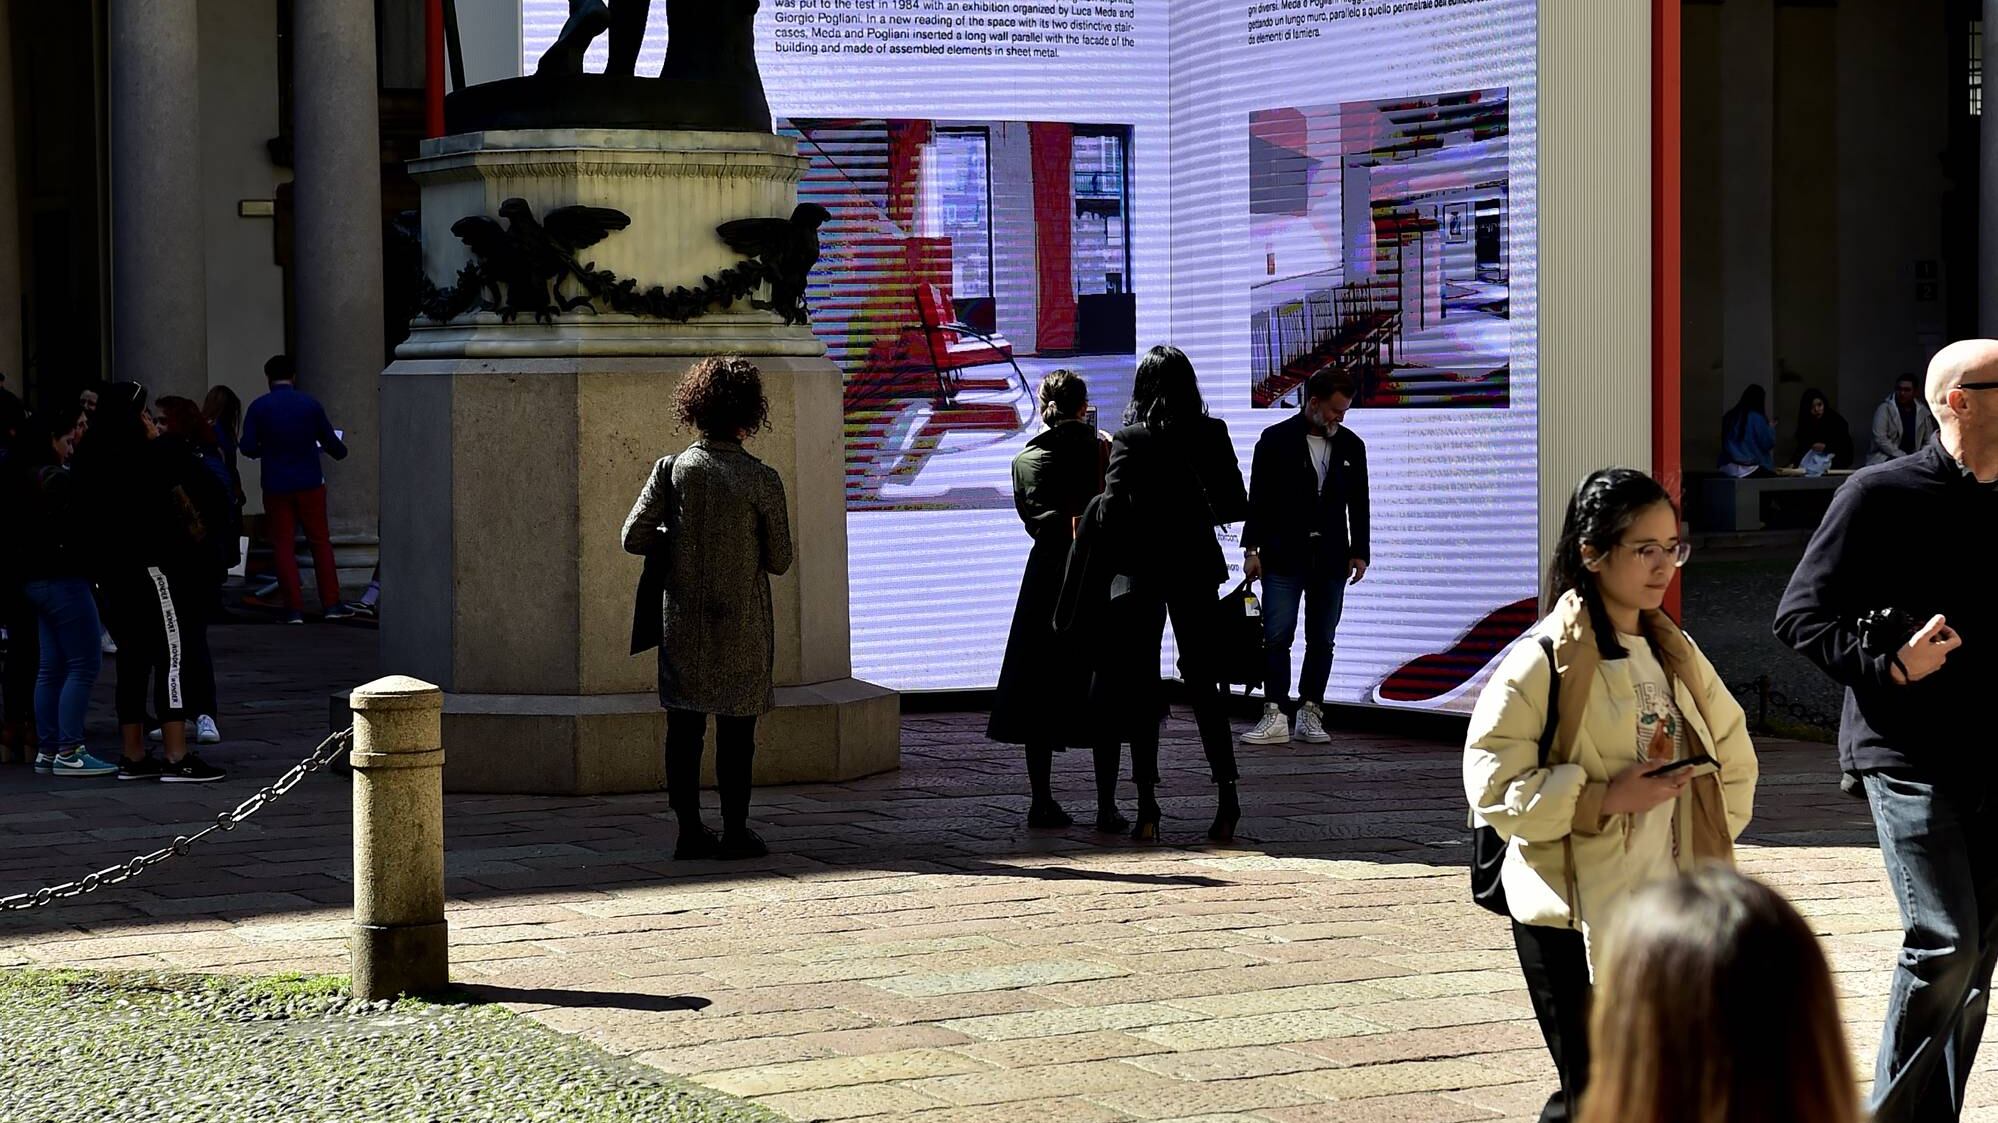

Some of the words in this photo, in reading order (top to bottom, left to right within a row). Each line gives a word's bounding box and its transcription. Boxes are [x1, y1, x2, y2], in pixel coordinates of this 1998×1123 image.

[774, 0, 796, 8] was
[800, 0, 816, 10] put
[820, 0, 831, 8] to
[835, 0, 852, 9] the
[855, 0, 875, 9] test
[879, 0, 888, 9] in
[893, 0, 920, 10] 1984
[924, 0, 944, 10] with
[947, 2, 959, 11] an
[962, 2, 1010, 12] exhibition
[1012, 4, 1056, 16] organized
[1058, 6, 1069, 17] by
[1072, 6, 1092, 16] Luca
[1095, 6, 1117, 17] Meda
[1120, 9, 1134, 18] and
[1286, 14, 1305, 26] lungo
[1330, 7, 1361, 22] parallelo
[1362, 8, 1367, 16] a
[775, 12, 815, 25] Giorgio
[818, 12, 863, 26] Pogliani.
[867, 14, 876, 24] In
[880, 16, 886, 24] a
[889, 16, 911, 24] new
[914, 14, 952, 28] reading
[956, 15, 965, 26] of
[969, 16, 984, 26] the
[987, 18, 1016, 29] space
[1019, 18, 1037, 28] with
[1040, 18, 1049, 28] its
[1052, 19, 1068, 30] two
[1070, 20, 1112, 32] distinctive
[1114, 22, 1134, 32] stair-
[775, 28, 808, 39] cases,
[812, 27, 841, 38] Meda
[844, 28, 864, 38] and
[867, 28, 910, 41] Pogliani
[913, 29, 953, 40] inserted
[956, 32, 962, 40] a
[965, 30, 986, 43] long
[989, 31, 1008, 41] wall
[1012, 32, 1043, 43] parallel
[1045, 33, 1063, 44] with
[1066, 34, 1079, 44] the
[1111, 36, 1120, 46] of
[1122, 36, 1134, 47] the
[776, 41, 818, 55] building
[821, 42, 840, 53] and
[844, 43, 873, 53] made
[876, 43, 886, 53] of
[889, 44, 944, 54] assembled
[947, 45, 992, 56] elements
[995, 46, 1003, 55] in
[1006, 46, 1031, 57] sheet
[1034, 48, 1058, 58] metal.
